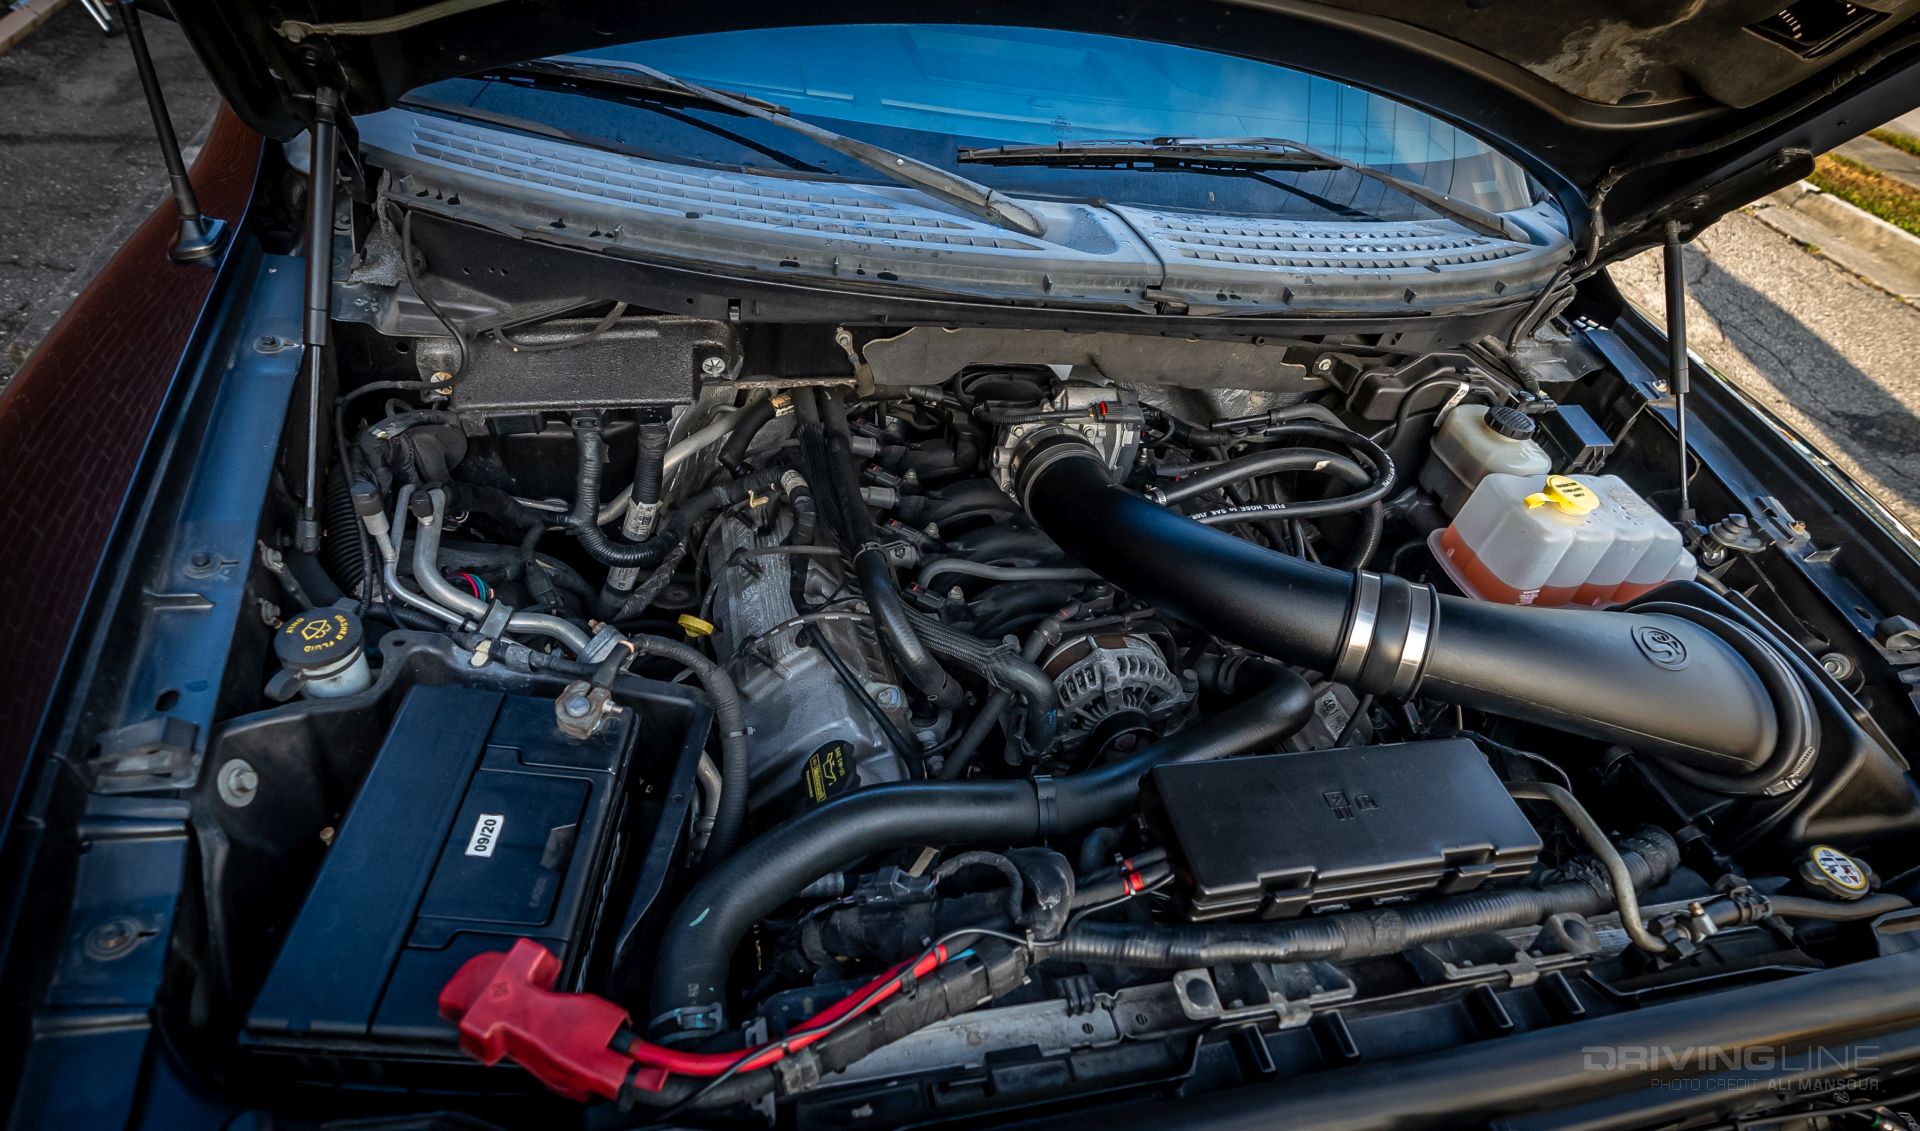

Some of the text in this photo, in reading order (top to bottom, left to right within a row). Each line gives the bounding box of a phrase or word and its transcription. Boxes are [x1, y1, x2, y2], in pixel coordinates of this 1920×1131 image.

[1210, 508, 1227, 516] SAE
[1240, 504, 1263, 512] HOSE
[285, 617, 305, 634] ONLY
[303, 614, 349, 653] WASHER FLUID
[474, 819, 497, 852] 09/20
